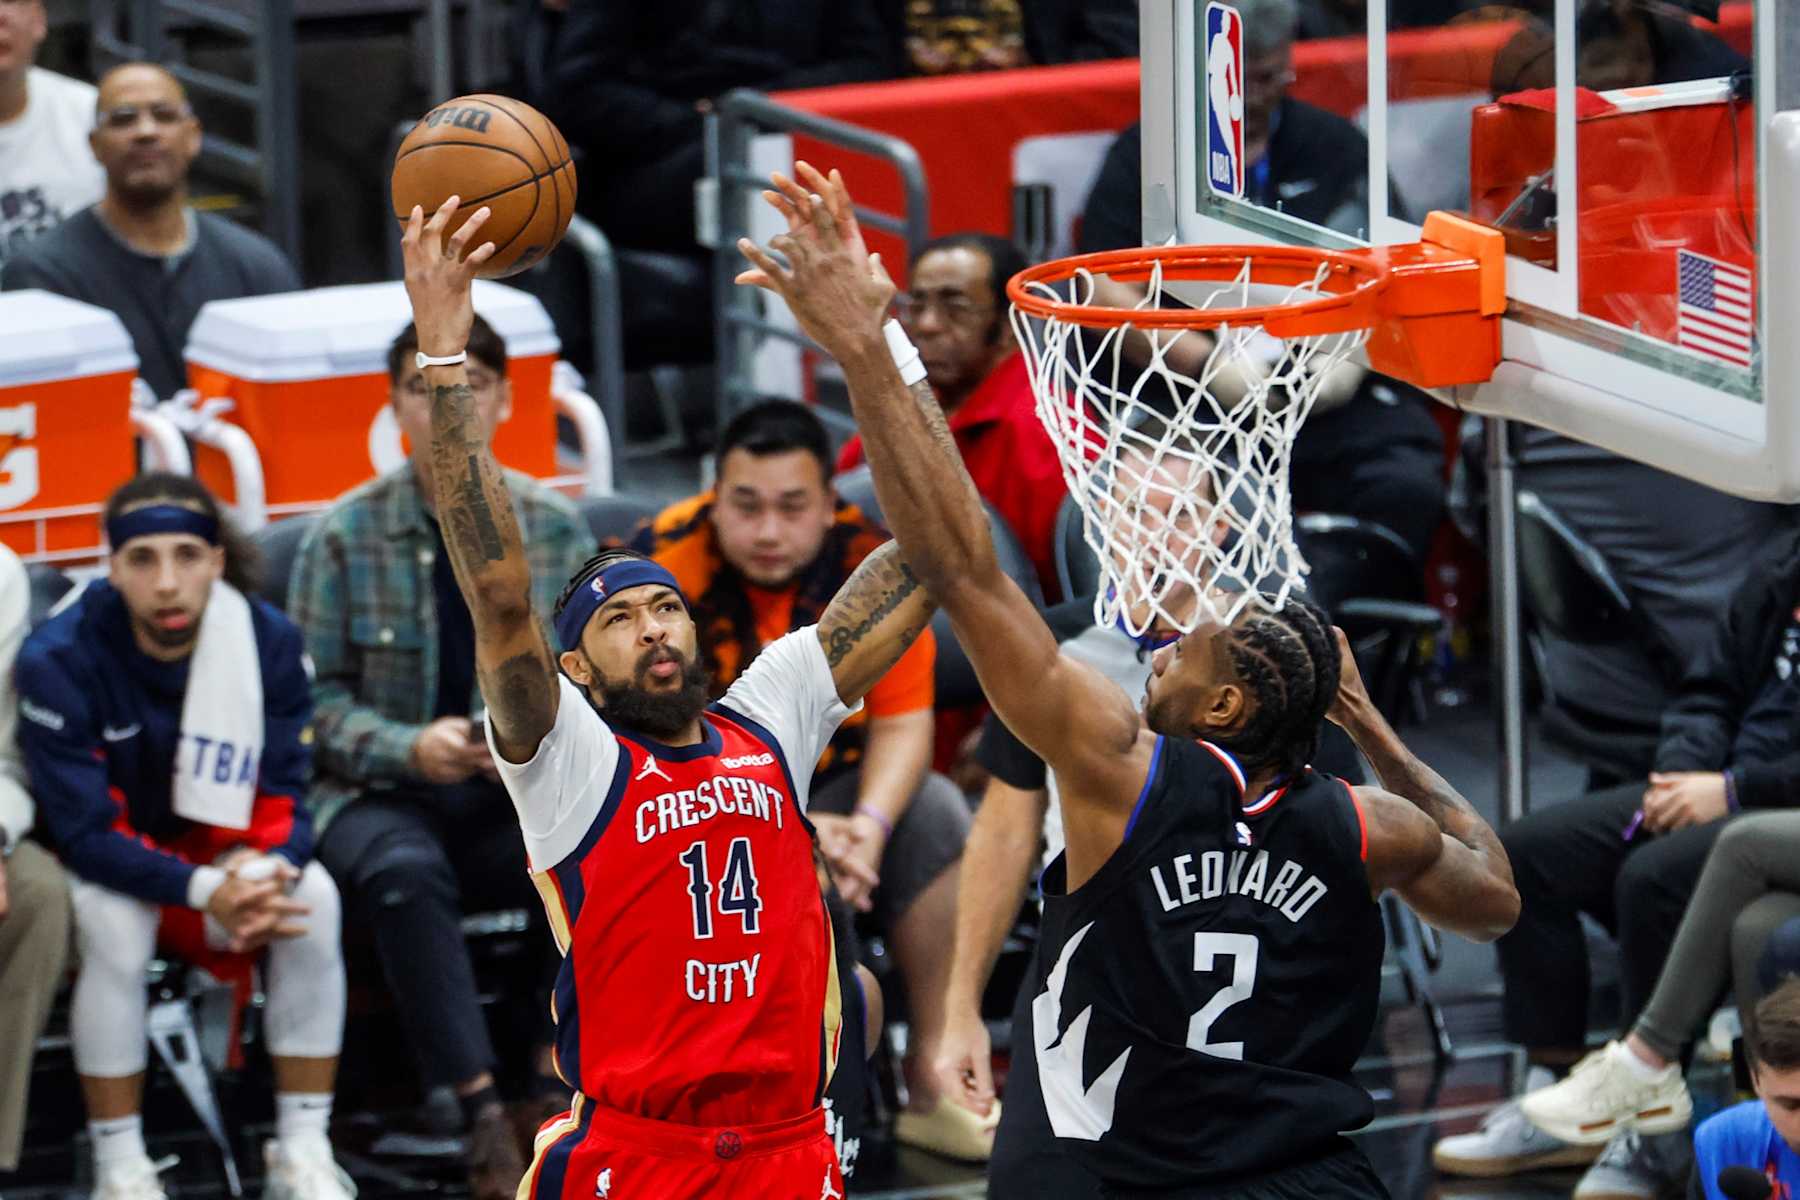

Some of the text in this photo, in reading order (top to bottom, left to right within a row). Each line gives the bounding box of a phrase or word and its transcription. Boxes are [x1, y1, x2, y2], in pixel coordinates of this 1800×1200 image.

[1212, 151, 1231, 184] NBA
[181, 735, 258, 786] TBA
[635, 776, 784, 843] CRESCENT
[677, 836, 763, 940] 14
[1150, 849, 1328, 923] LEONARD
[685, 953, 760, 1003] CITY
[1186, 932, 1259, 1061] 2
